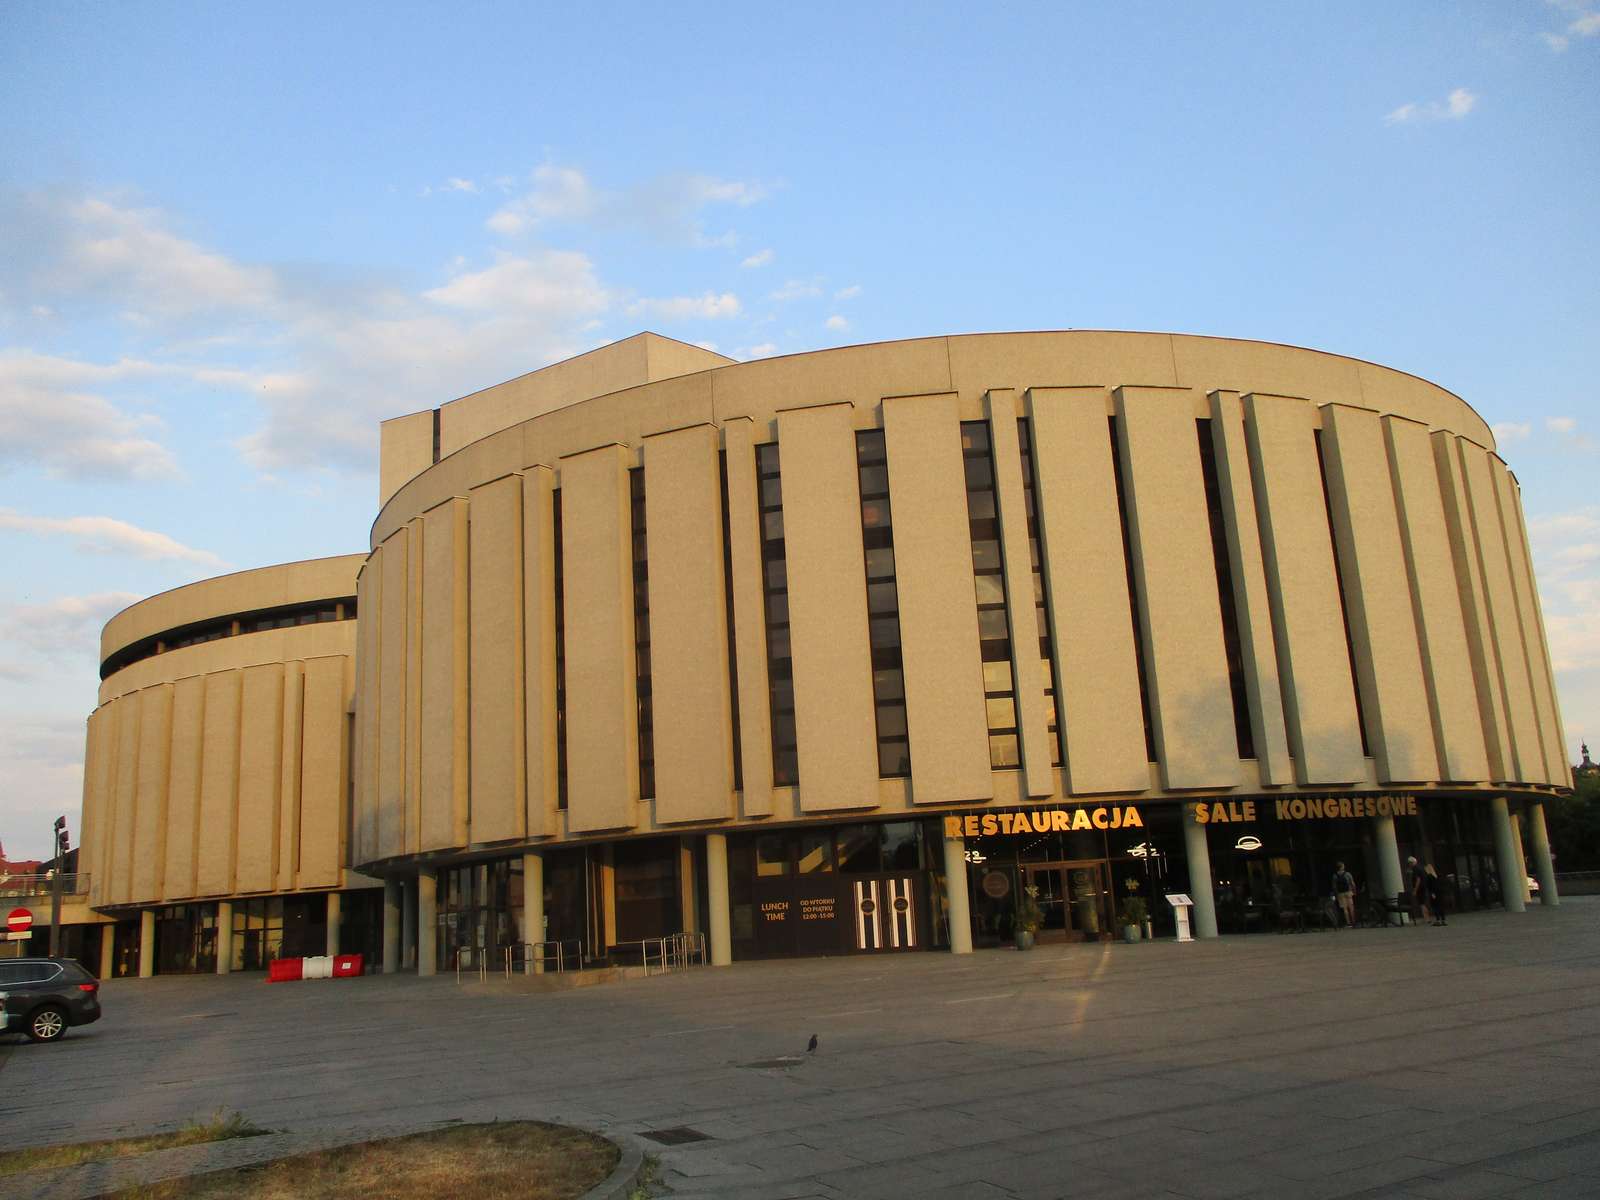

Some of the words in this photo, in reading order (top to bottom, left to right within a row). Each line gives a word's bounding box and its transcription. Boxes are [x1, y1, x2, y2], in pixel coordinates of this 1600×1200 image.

[1195, 801, 1256, 823] SALE
[1276, 797, 1417, 820] KONGRESOWE
[944, 807, 1144, 837] RESTAURACJA
[761, 902, 789, 911] LUNCH
[766, 912, 785, 921] TIME
